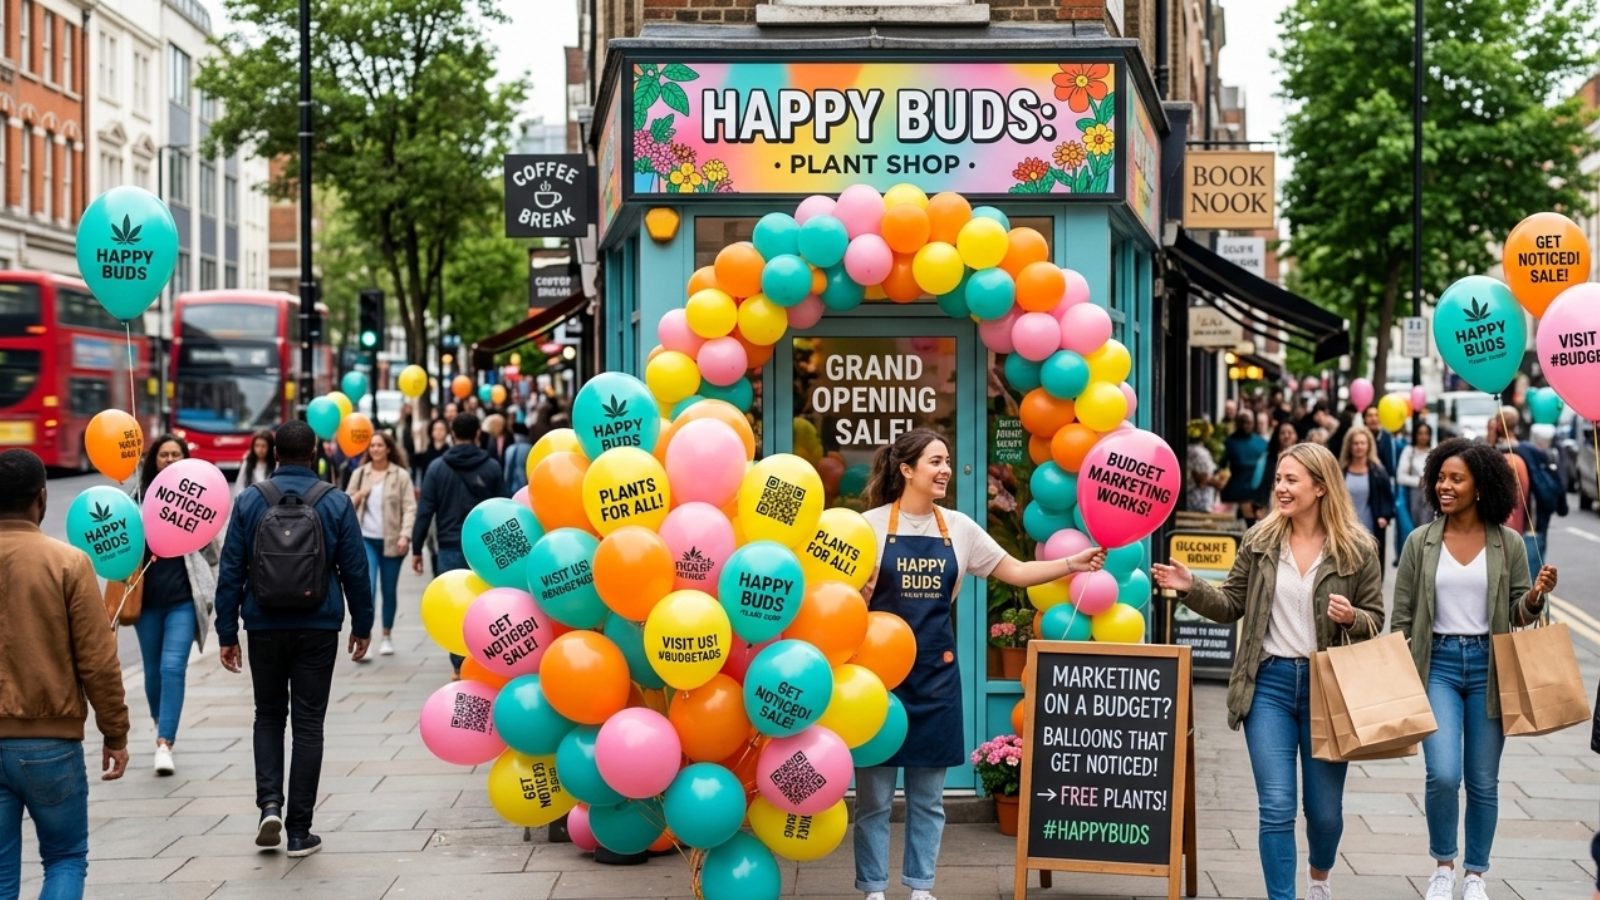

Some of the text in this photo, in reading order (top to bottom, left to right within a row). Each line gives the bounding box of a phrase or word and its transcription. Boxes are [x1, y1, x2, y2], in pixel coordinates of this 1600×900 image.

[700, 88, 1058, 144] HAPPY BUDS:
[512, 161, 580, 187] COFFEE
[790, 154, 961, 175] PLANT SHOP
[1192, 165, 1267, 187] BOOK
[1190, 192, 1268, 214] NOOK
[518, 206, 576, 229] BREAK
[1536, 235, 1562, 249] GET
[96, 248, 155, 264] HAPPY
[1518, 251, 1580, 267] NOTICED!
[102, 265, 148, 281] BUDS
[1530, 268, 1569, 283] SALE!
[1455, 320, 1506, 344] HAPPY
[1558, 331, 1597, 349] VISIT
[1464, 336, 1506, 357] BUDS
[825, 354, 923, 381] GRAND
[811, 386, 937, 414] OPENING
[593, 418, 643, 438] HAPPY
[601, 434, 641, 451] BUDS
[1106, 451, 1166, 482] BUDGET
[178, 478, 207, 499] GET
[599, 477, 657, 504] PLANTS
[1087, 465, 1171, 504] MARKETING
[155, 485, 217, 524] NOTICED!
[601, 493, 664, 522] FOR ALL!
[1096, 486, 1153, 517] WORKS!
[84, 517, 127, 544] HAPPY
[814, 530, 860, 562] PLANTS
[806, 541, 857, 577] FOR ALL!
[896, 557, 946, 573] HAPPY
[540, 567, 569, 588] VISIT
[738, 571, 794, 596] HAPPY
[902, 575, 942, 590] BUDS
[741, 590, 785, 612] BUDS
[662, 635, 695, 650] VISIT
[1052, 664, 1161, 691] MARKETING
[777, 681, 804, 701] GET
[1044, 693, 1173, 720] ON A BUDGET?
[1042, 726, 1168, 752] BALLOONS THAT
[1051, 752, 1158, 777] GET NOTICED!
[1060, 785, 1167, 812] FREE PLANTS!
[1042, 819, 1151, 846] #HAPPYBUDS
